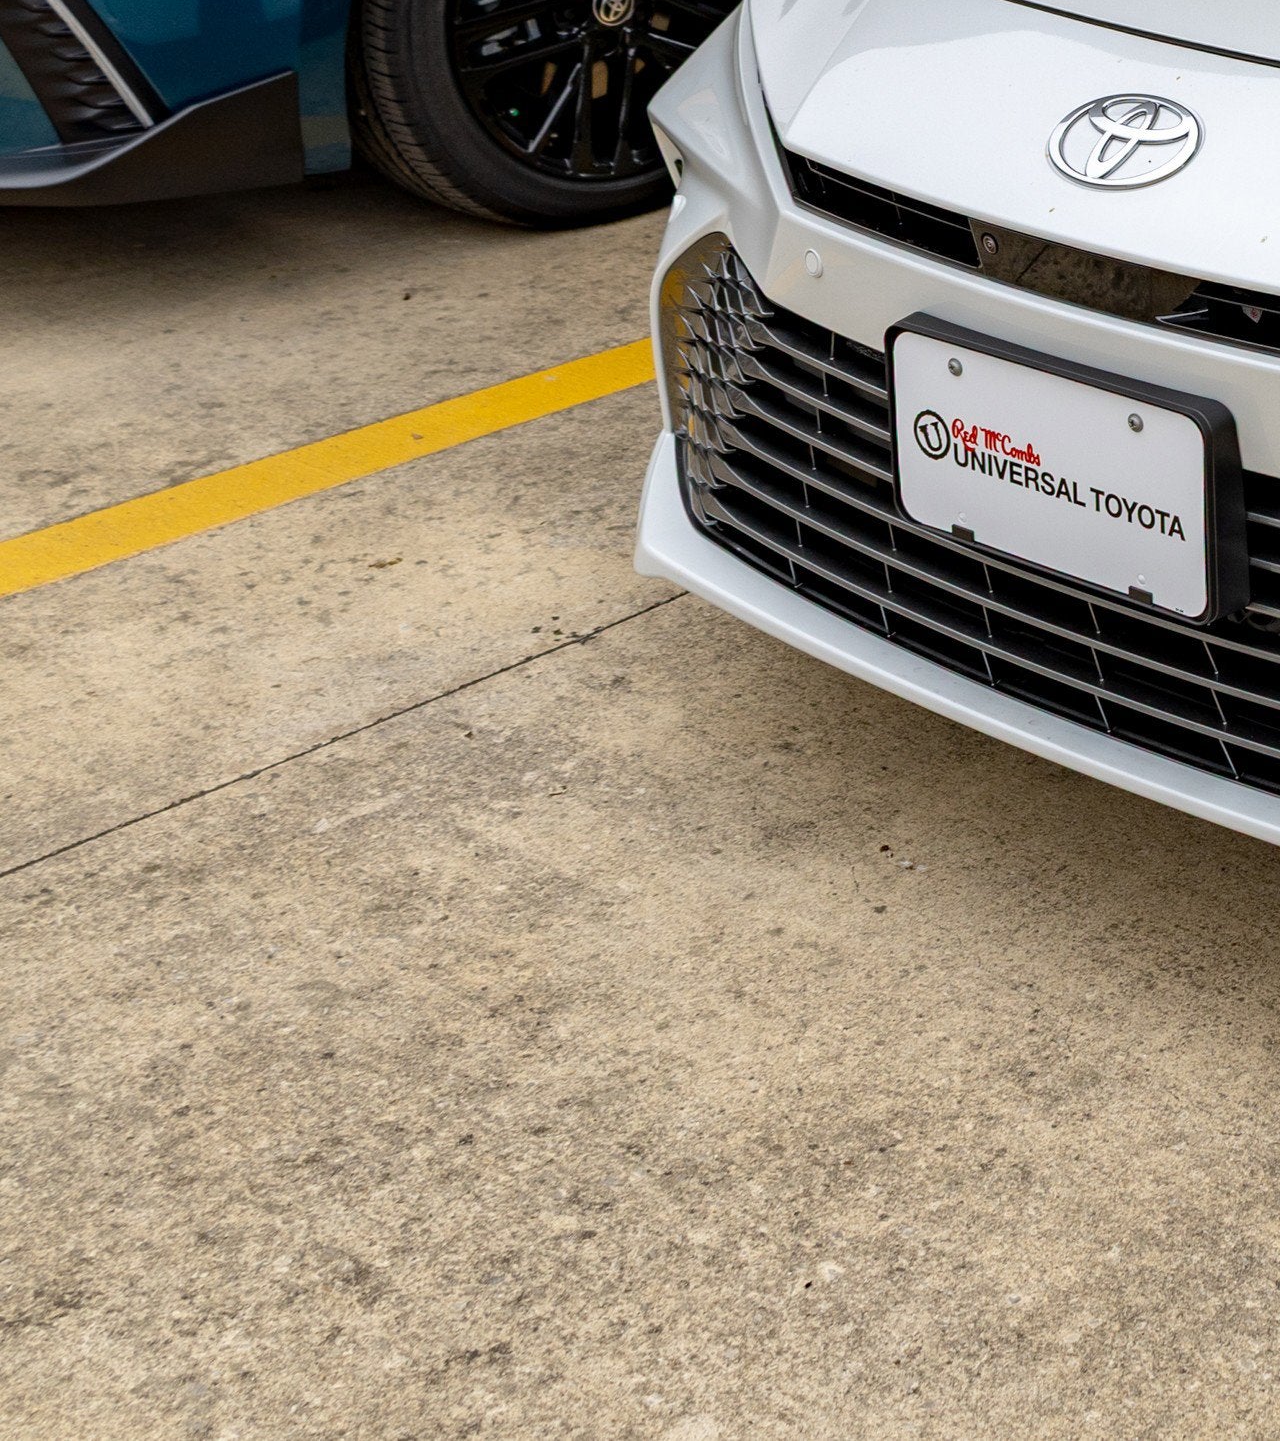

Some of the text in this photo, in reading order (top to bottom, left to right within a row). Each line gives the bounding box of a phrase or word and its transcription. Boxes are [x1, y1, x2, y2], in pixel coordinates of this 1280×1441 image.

[952, 418, 1042, 467] Red McCombs
[953, 442, 1186, 542] UNIVERSAL TOYOTA
